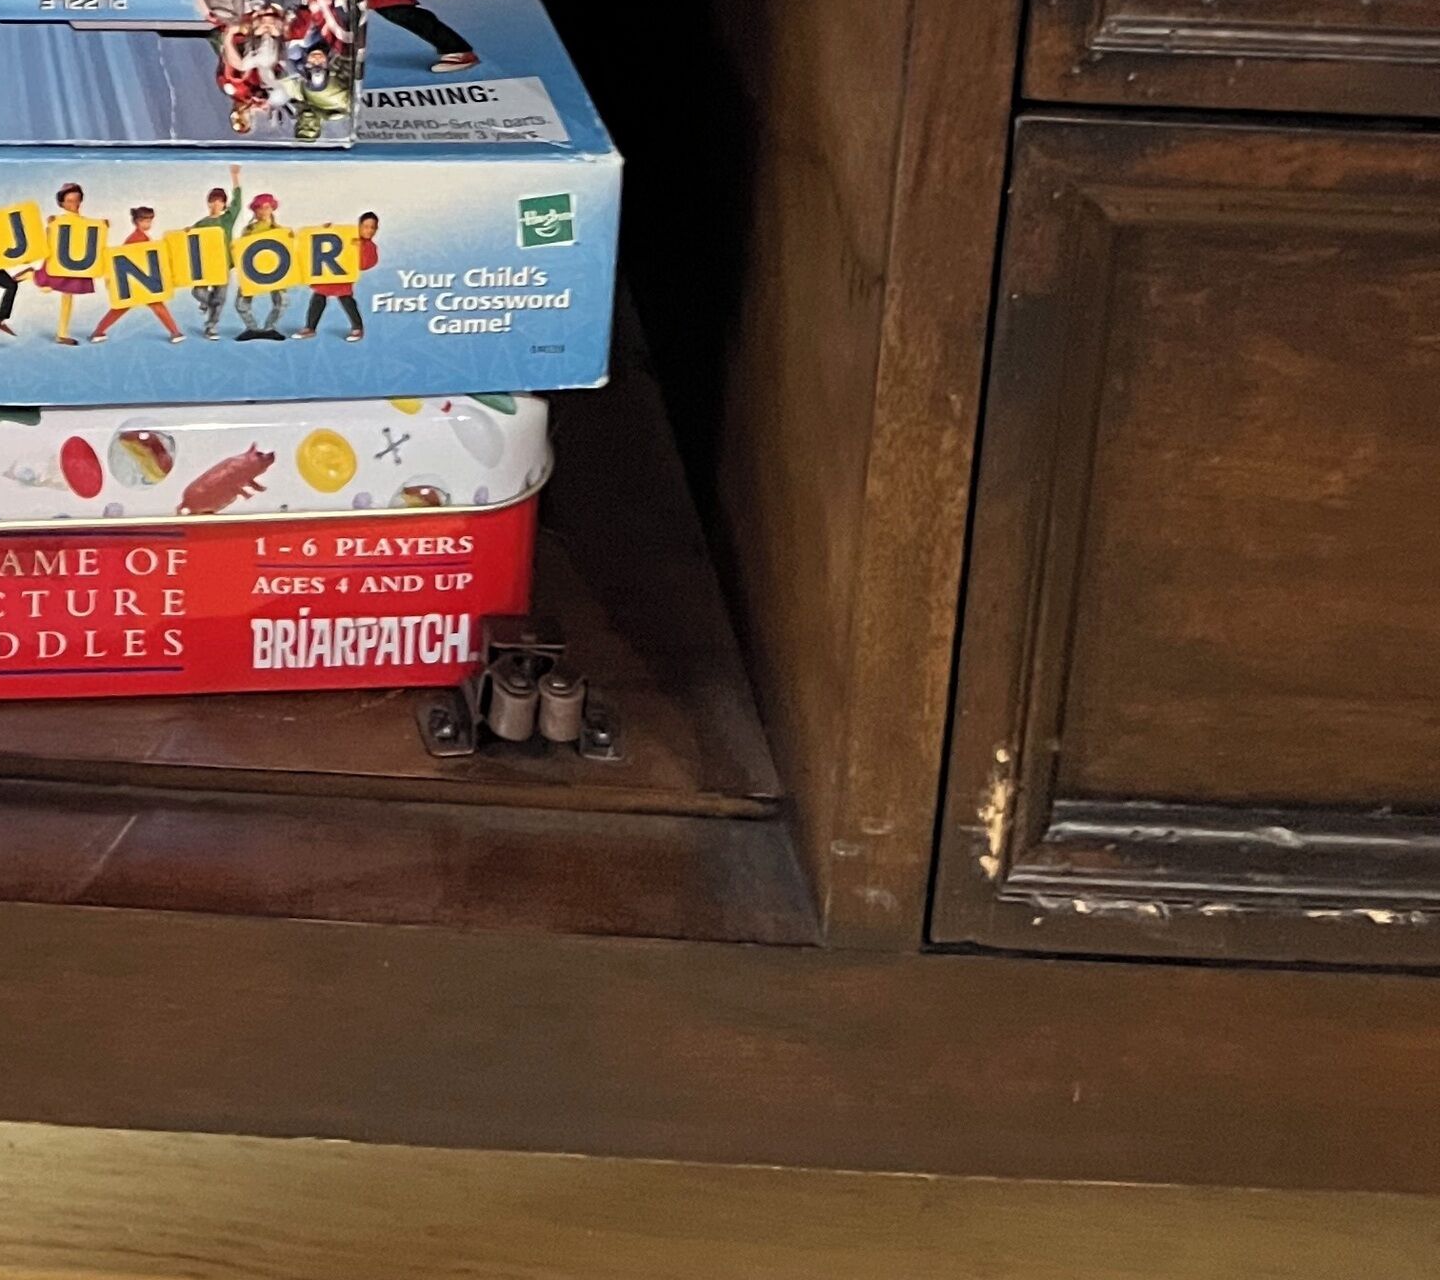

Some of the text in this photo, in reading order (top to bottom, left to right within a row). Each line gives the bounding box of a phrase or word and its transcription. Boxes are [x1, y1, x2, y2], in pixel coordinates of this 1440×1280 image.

[0, 208, 344, 302] JUNIOR
[397, 265, 548, 289] Your Child's
[372, 288, 571, 313] First Crossword
[428, 312, 513, 336] Game!
[302, 538, 319, 558] 6
[336, 535, 474, 557] PLAYERS
[124, 547, 189, 576] OF
[252, 572, 474, 596] AGES 4 AND UP
